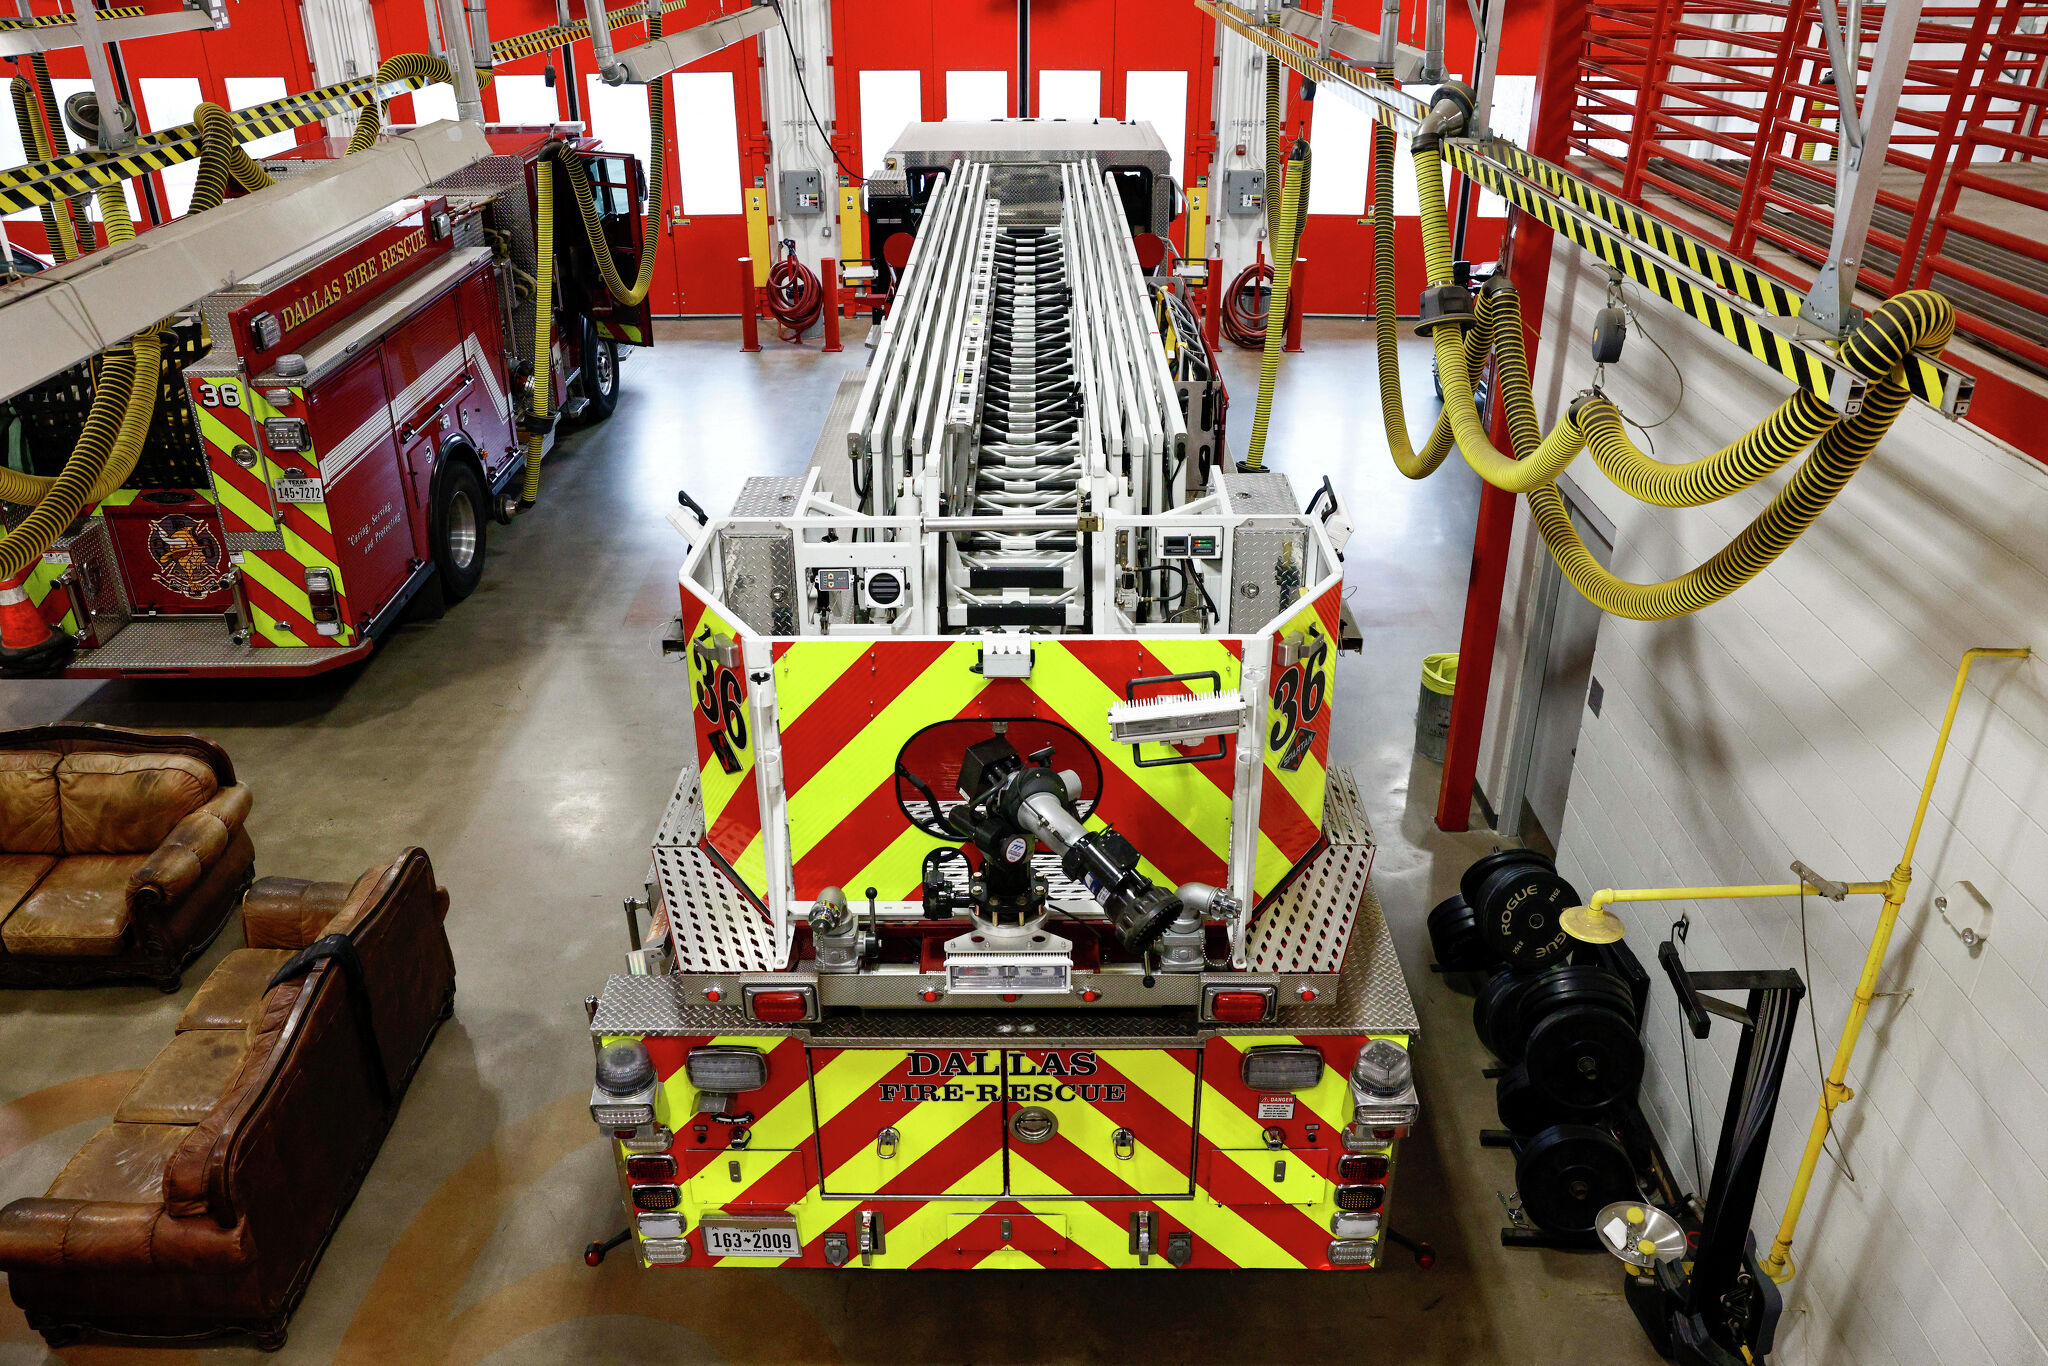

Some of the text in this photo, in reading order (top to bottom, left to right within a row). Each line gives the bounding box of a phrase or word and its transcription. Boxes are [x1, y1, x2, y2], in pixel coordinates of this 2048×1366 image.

[281, 227, 428, 334] DALLAS FIRE RESCUE
[199, 383, 241, 408] 36
[693, 637, 748, 751] 36
[1269, 641, 1328, 752] 36
[1282, 734, 1314, 768] SPARTAN
[1501, 884, 1538, 936] ROGUE
[907, 1052, 1098, 1076] DALLAS
[879, 1083, 1126, 1102] FIRE-RESCUE
